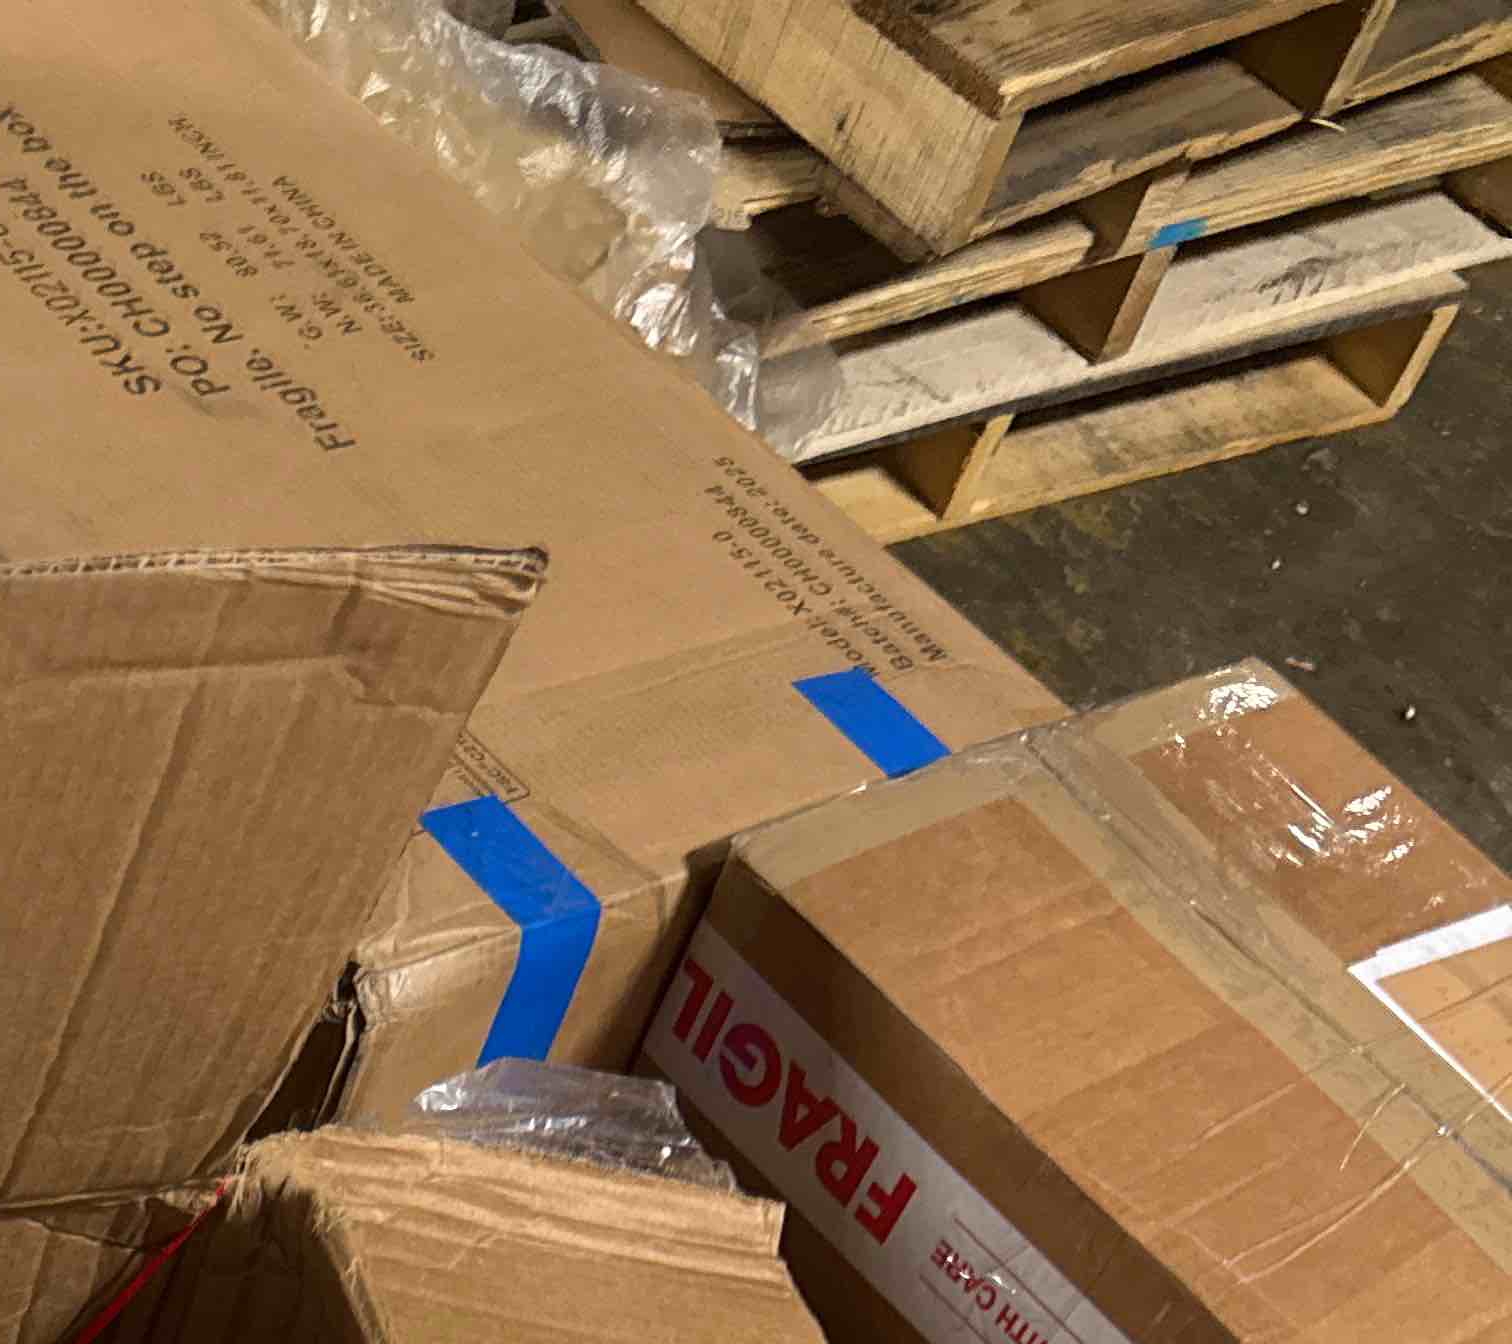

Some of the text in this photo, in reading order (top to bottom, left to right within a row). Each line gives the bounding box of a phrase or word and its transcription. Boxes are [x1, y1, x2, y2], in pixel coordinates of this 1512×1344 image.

[44, 157, 98, 199] the
[90, 203, 135, 236] on
[272, 175, 414, 304] MADE IN CHINA
[129, 242, 201, 299] step
[194, 304, 244, 344] No
[165, 344, 231, 396] PO:
[246, 348, 356, 452] Fragile.
[712, 530, 809, 616] X02115-0
[818, 548, 948, 662] Manufacture
[671, 957, 918, 1247] FRAGIL
[929, 1239, 997, 1311] CARE
